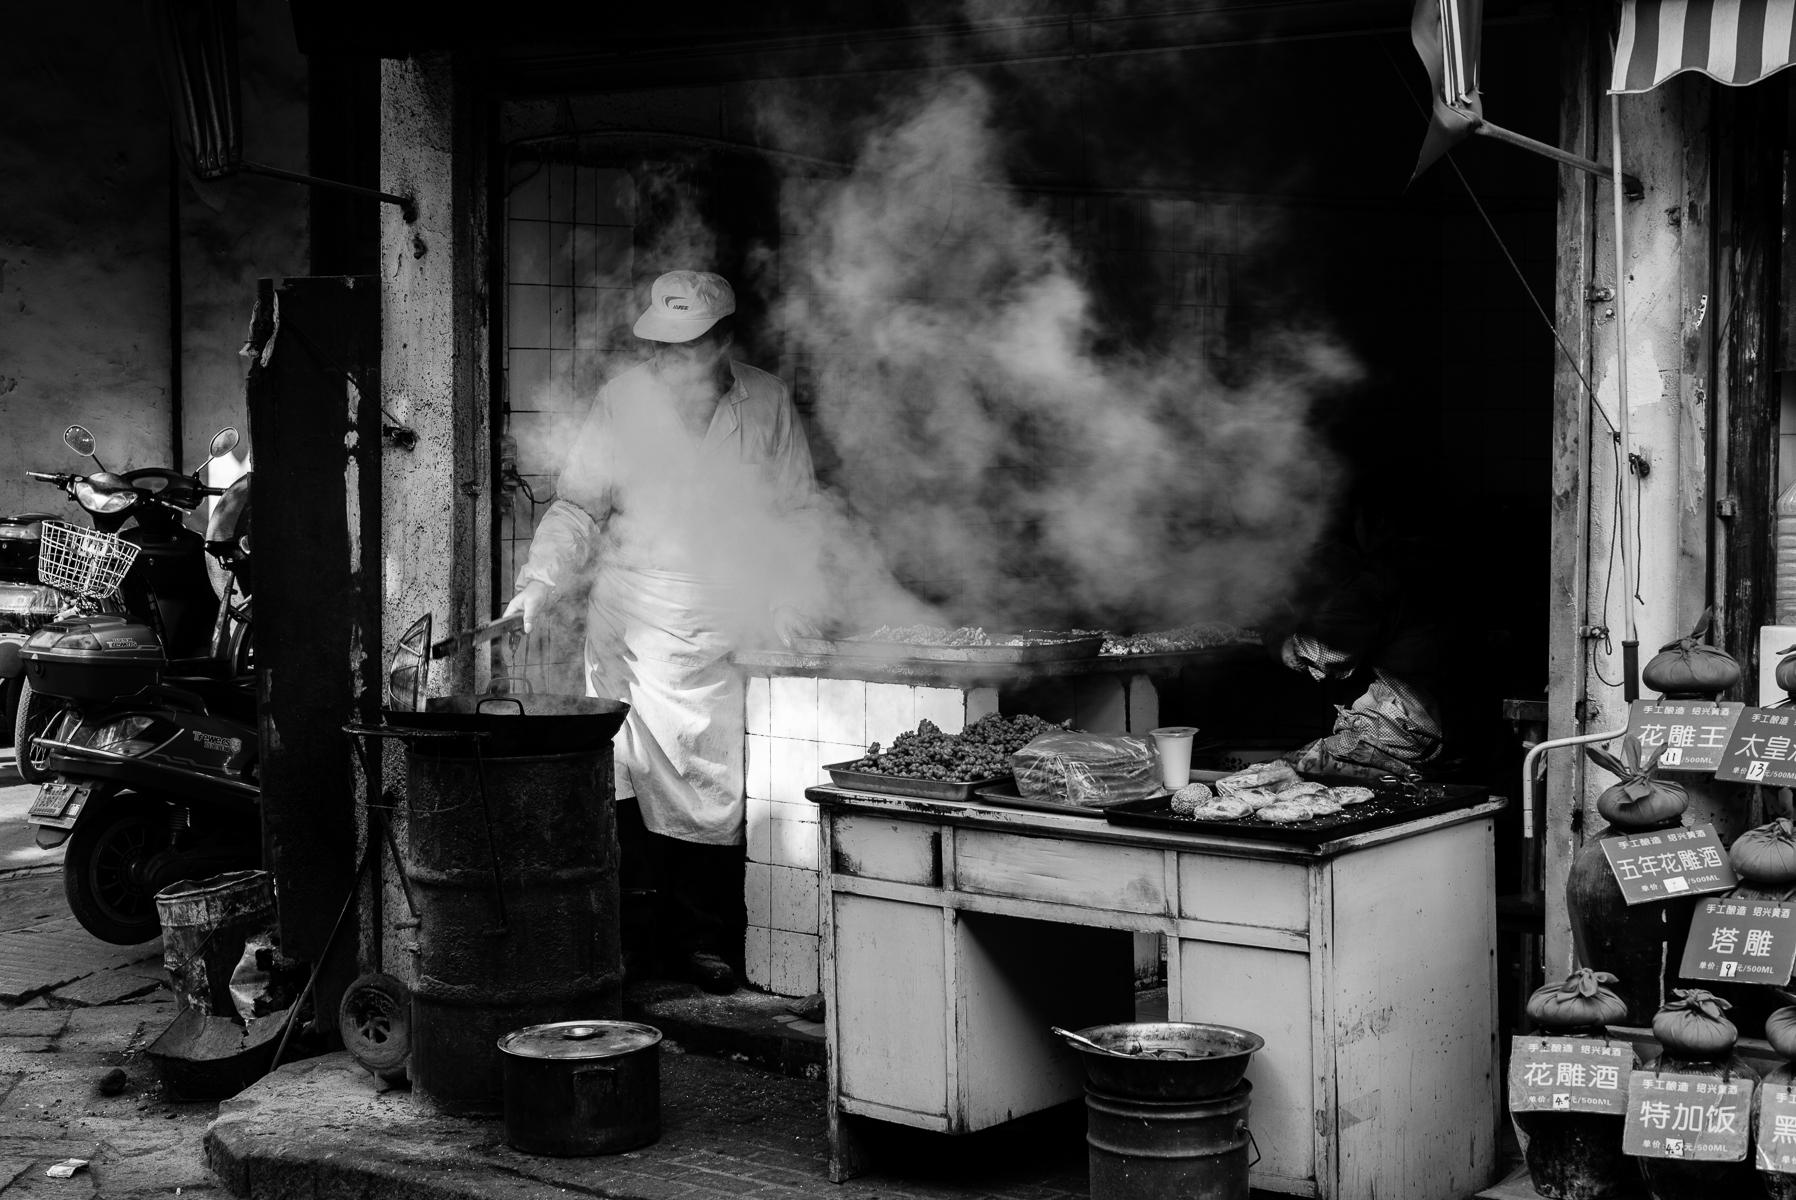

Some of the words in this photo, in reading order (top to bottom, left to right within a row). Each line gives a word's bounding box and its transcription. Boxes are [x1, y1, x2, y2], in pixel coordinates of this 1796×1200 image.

[1643, 705, 1685, 715] 手工酿造
[1691, 706, 1730, 716] 绍兴黄酒
[1751, 713, 1789, 726] 手工酿造
[1637, 724, 1727, 748] 花雕王
[1734, 733, 1796, 762] 太皇
[1750, 763, 1765, 777] 13
[1617, 836, 1662, 850] 手工酿造
[1667, 829, 1706, 842] 绍兴黄酒
[1617, 846, 1723, 880] 五年花雕酒
[1706, 903, 1747, 916] 手工酿造
[1752, 906, 1792, 919] 绍兴黄酒
[1708, 927, 1774, 957] 塔雕
[1725, 963, 1732, 976] 9
[1528, 1043, 1573, 1053] 手工酿造
[1581, 1045, 1622, 1056] 绍兴黄酒
[1524, 1062, 1619, 1089] 花雕酒
[1642, 1079, 1688, 1092] 手工酿造
[1696, 1083, 1738, 1094] 绍兴黄酒
[1639, 1100, 1736, 1134] 特加饭
[1772, 1115, 1796, 1144] 黑
